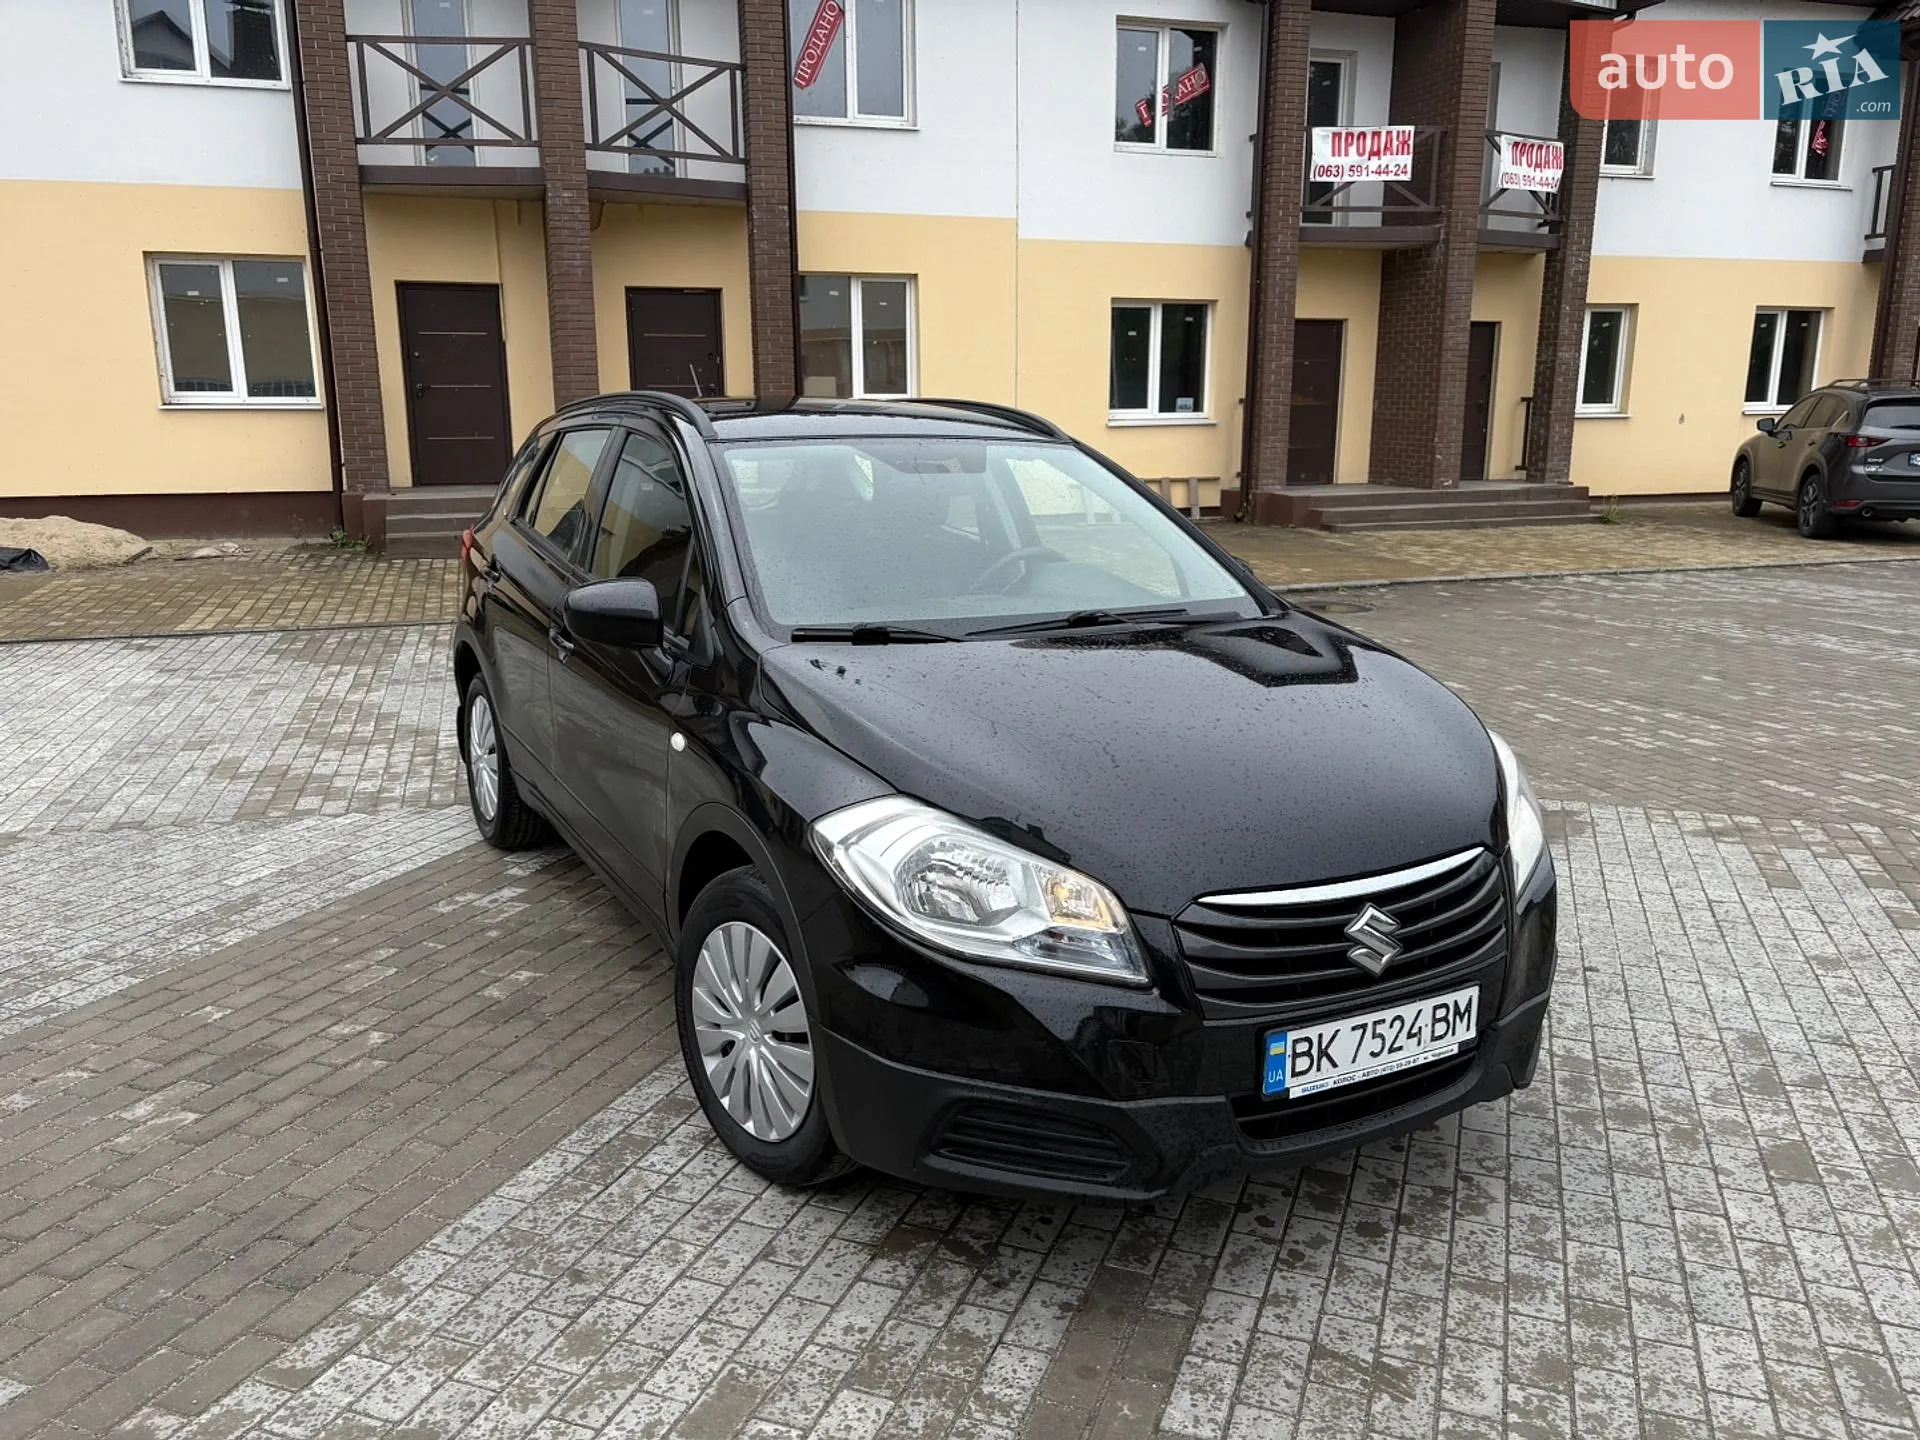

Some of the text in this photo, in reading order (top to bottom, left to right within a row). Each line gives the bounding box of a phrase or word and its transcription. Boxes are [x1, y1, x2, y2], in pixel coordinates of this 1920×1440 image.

[794, 1, 839, 86] ПРОДАНО
[1331, 130, 1412, 160] ПРОДАЖ
[1511, 141, 1563, 171] ПРОДАЖ
[1313, 163, 1409, 179] (063) 591-44-24
[1500, 172, 1560, 189] (063) 591-44-24
[1290, 995, 1473, 1079] BK 7524 BM
[1268, 1069, 1284, 1084] UA
